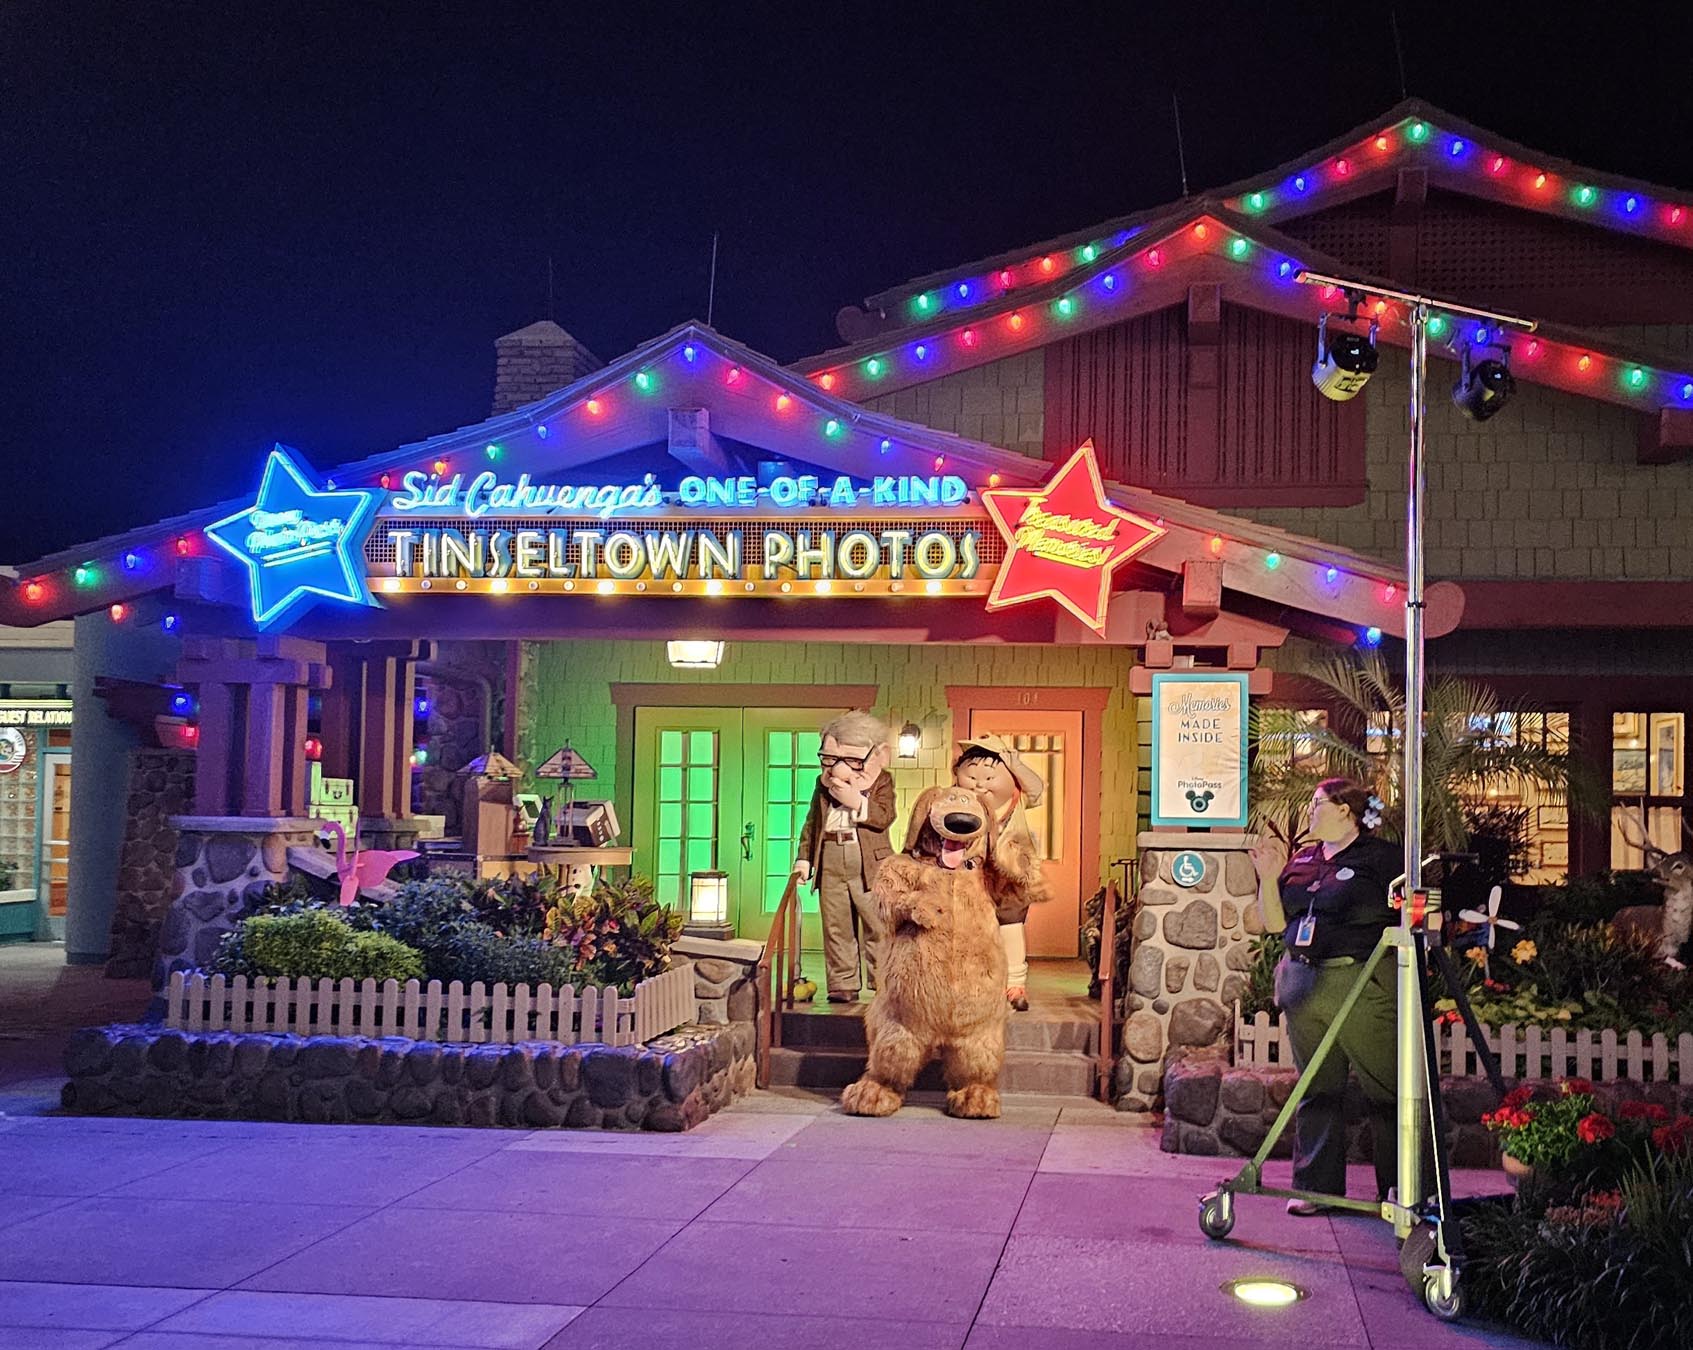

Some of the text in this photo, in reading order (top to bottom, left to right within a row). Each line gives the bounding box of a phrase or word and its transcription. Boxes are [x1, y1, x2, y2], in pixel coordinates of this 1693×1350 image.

[393, 471, 969, 518] Sid Cahuenga's ONE-OF-A-KIND
[387, 528, 741, 579] TINSELTOWN
[764, 530, 983, 579] PHOTOS
[1168, 693, 1231, 719] Memories
[1180, 718, 1221, 730] MADE
[1178, 732, 1223, 743] INSIDE
[1177, 780, 1222, 789] PhotoPass
